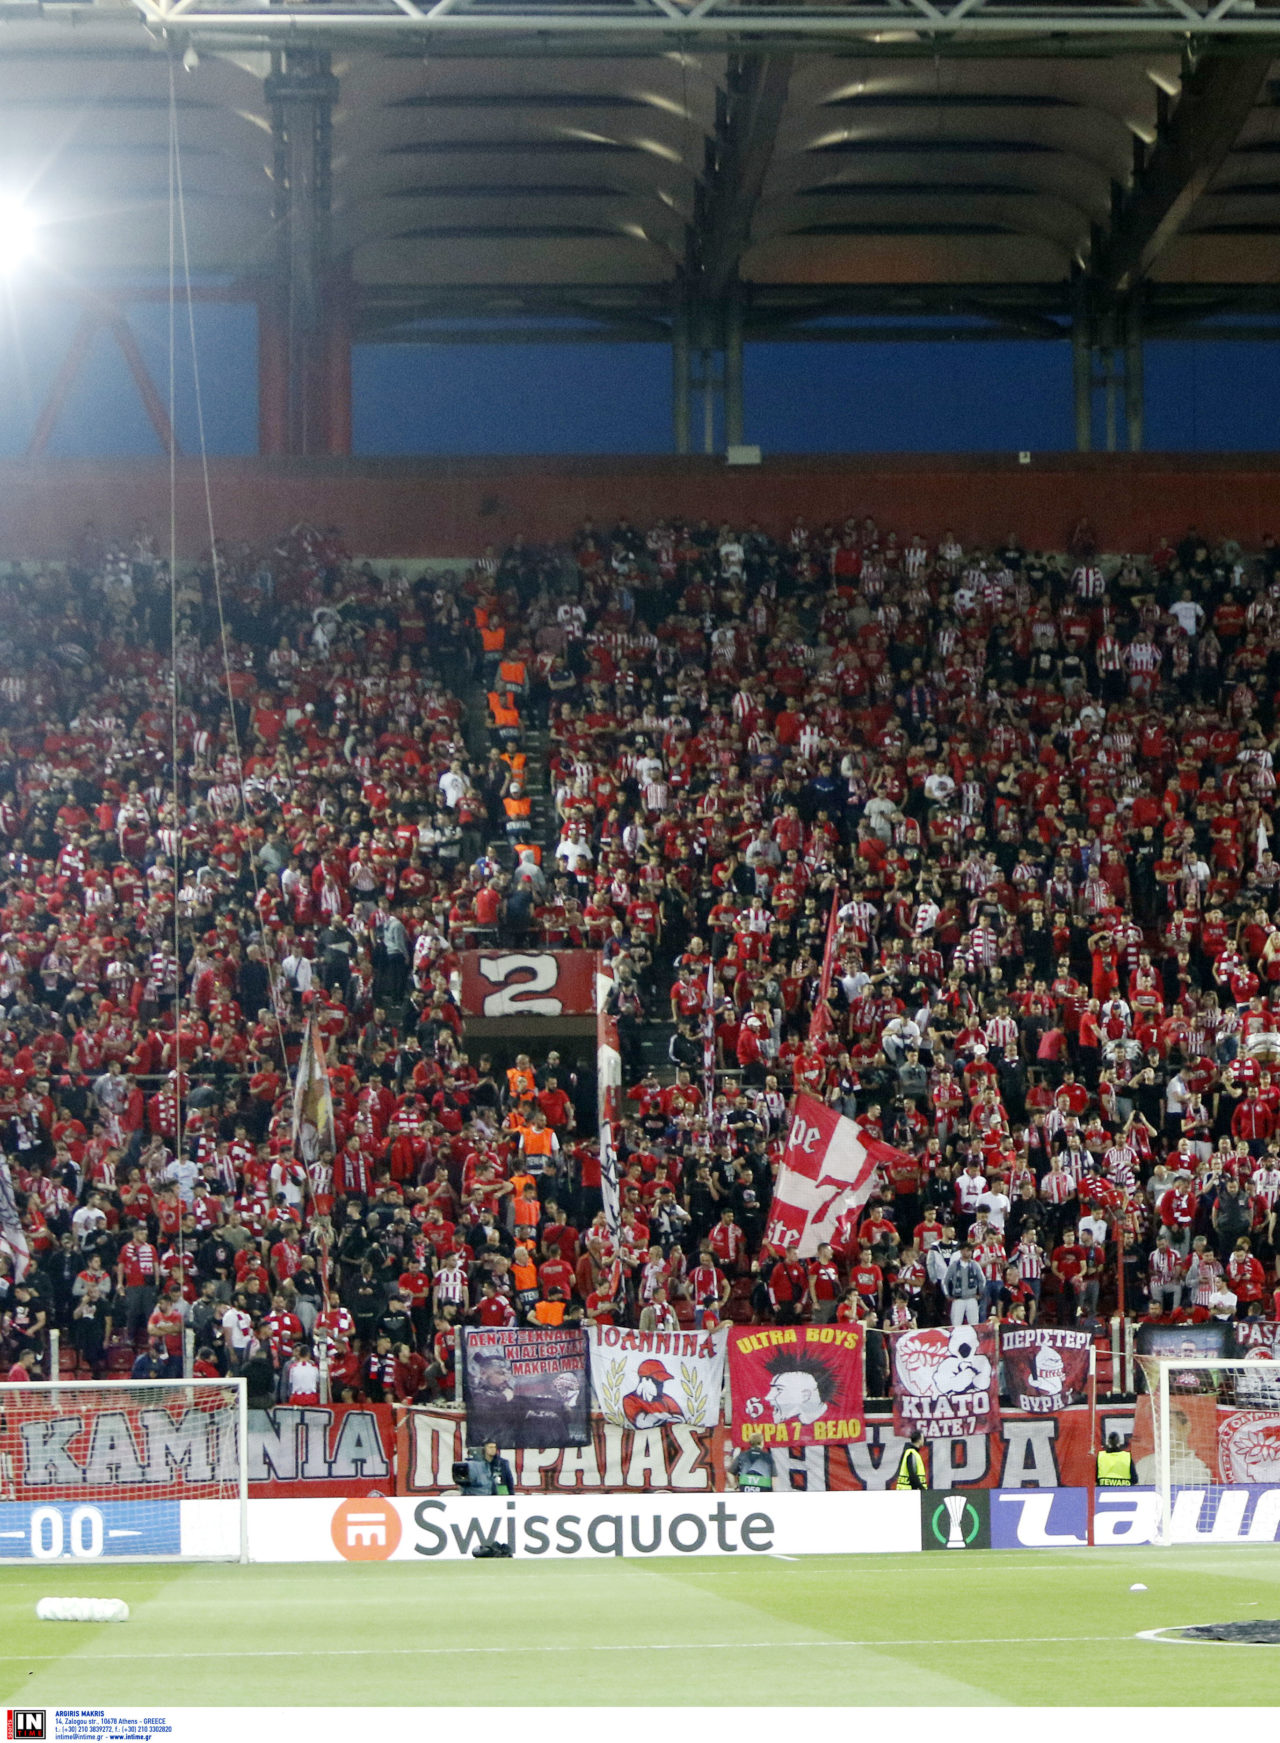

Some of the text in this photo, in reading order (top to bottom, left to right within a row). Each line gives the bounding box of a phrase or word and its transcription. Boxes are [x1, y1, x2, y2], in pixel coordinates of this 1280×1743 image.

[480, 953, 563, 1017] 2
[468, 1332, 496, 1347] ΔΕΝ
[499, 1331, 515, 1345] ΣΕ
[736, 1327, 859, 1354] ULTRA BOYS
[1002, 1329, 1092, 1351] ΠΕΡΙΣΤΕΡΙ
[512, 1359, 559, 1375] ΜΑΚΡΙΑ
[916, 1416, 977, 1438] GATE 7
[412, 1411, 713, 1488] ΠΡΑΙΑΣ
[747, 1476, 760, 1484] TV
[413, 1500, 775, 1556] Swissquote
